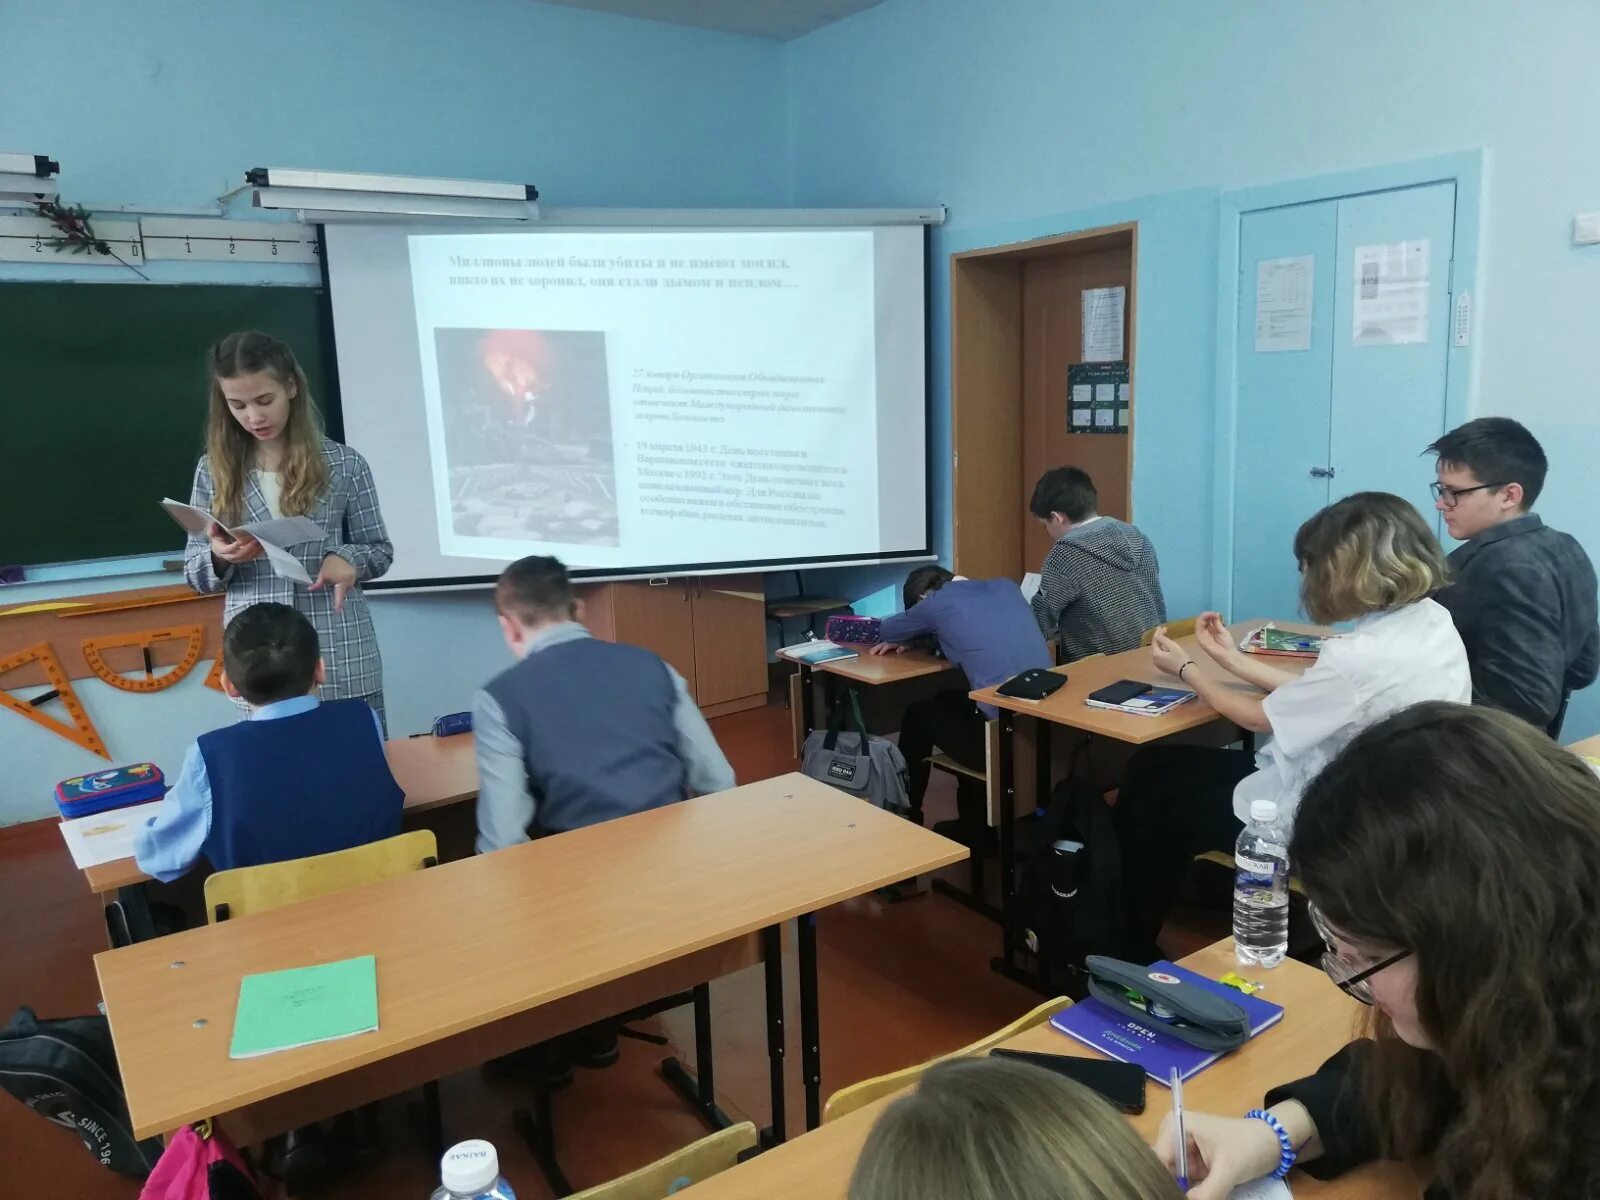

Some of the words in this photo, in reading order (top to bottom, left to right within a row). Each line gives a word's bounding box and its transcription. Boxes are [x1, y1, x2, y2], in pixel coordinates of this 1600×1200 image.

[185, 242, 192, 253] 1
[229, 243, 235, 254] 2
[272, 244, 278, 255] 3
[312, 245, 319, 256] 4
[449, 255, 522, 269] Миллионы
[527, 256, 565, 269] людей
[568, 255, 606, 268] были
[608, 256, 653, 272] убиты
[656, 259, 666, 269] и
[670, 259, 686, 269] не
[689, 259, 736, 269] имеют
[449, 276, 488, 286] никто
[490, 277, 507, 286] их
[509, 277, 524, 286] не
[590, 278, 615, 288] они
[618, 278, 659, 288] стали
[662, 278, 711, 290] дымом
[715, 278, 724, 289] и
[1127, 1022, 1156, 1038] OPEN
[78, 1117, 107, 1143] SINCE
